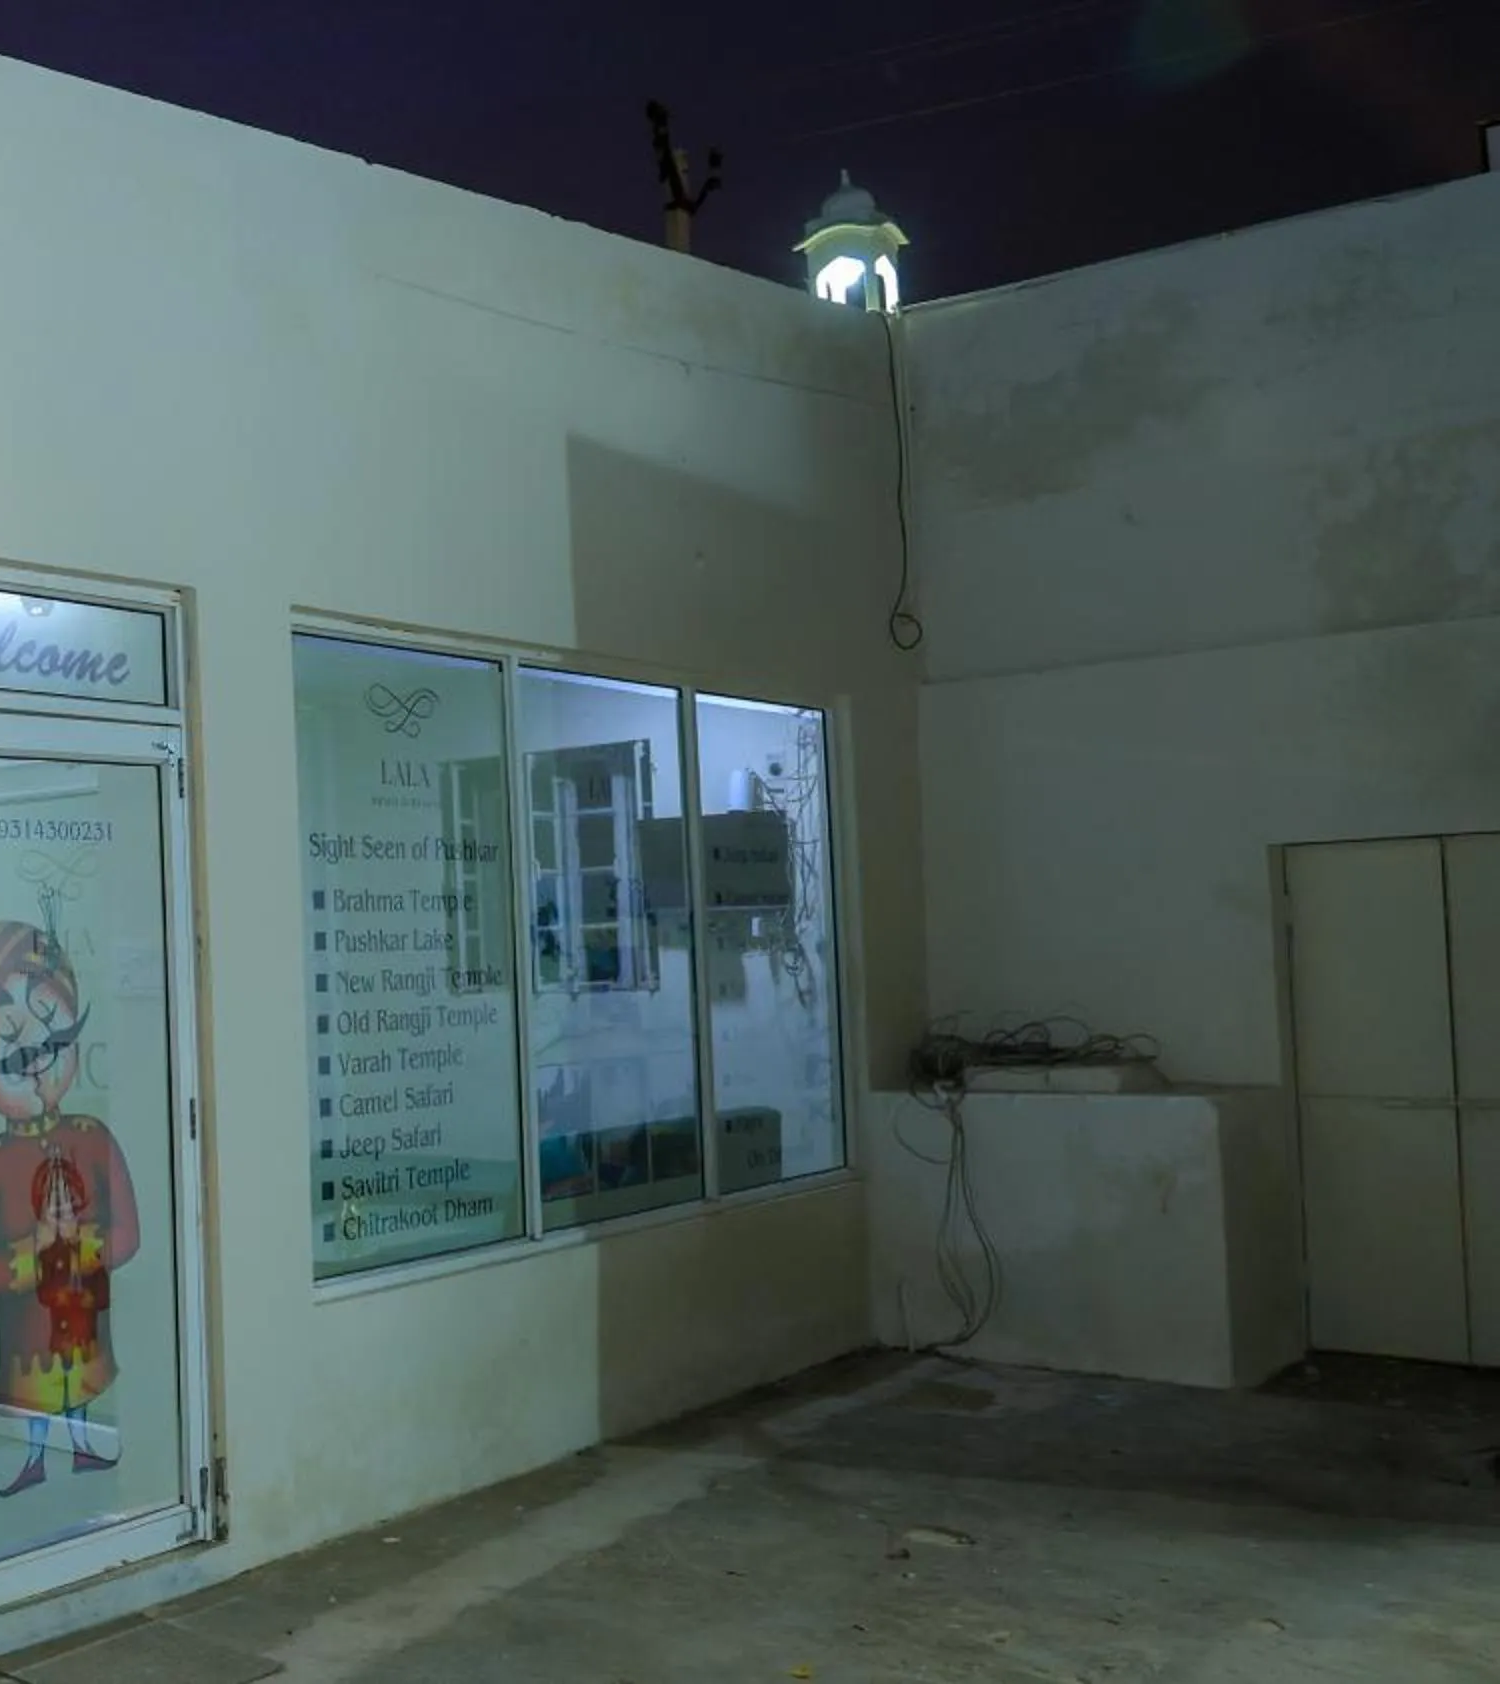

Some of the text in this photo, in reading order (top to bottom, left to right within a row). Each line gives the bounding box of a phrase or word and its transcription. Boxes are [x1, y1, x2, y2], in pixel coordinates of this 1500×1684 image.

[380, 758, 432, 788] LALA
[309, 832, 355, 865] Sight
[361, 834, 406, 861] Seen
[411, 835, 430, 862] of
[333, 888, 405, 913] Brahma
[334, 927, 454, 955] Pushkar Lake
[336, 962, 503, 998] New Rangji Temple
[337, 1001, 498, 1038] Old Rangji Temple
[338, 1043, 465, 1078] Varah Temple
[339, 1081, 454, 1119] Camel Safari
[339, 1122, 442, 1163] Jeep Safari
[341, 1157, 472, 1202] Savitri Temple
[343, 1196, 494, 1242] Chitrakoot Dham
